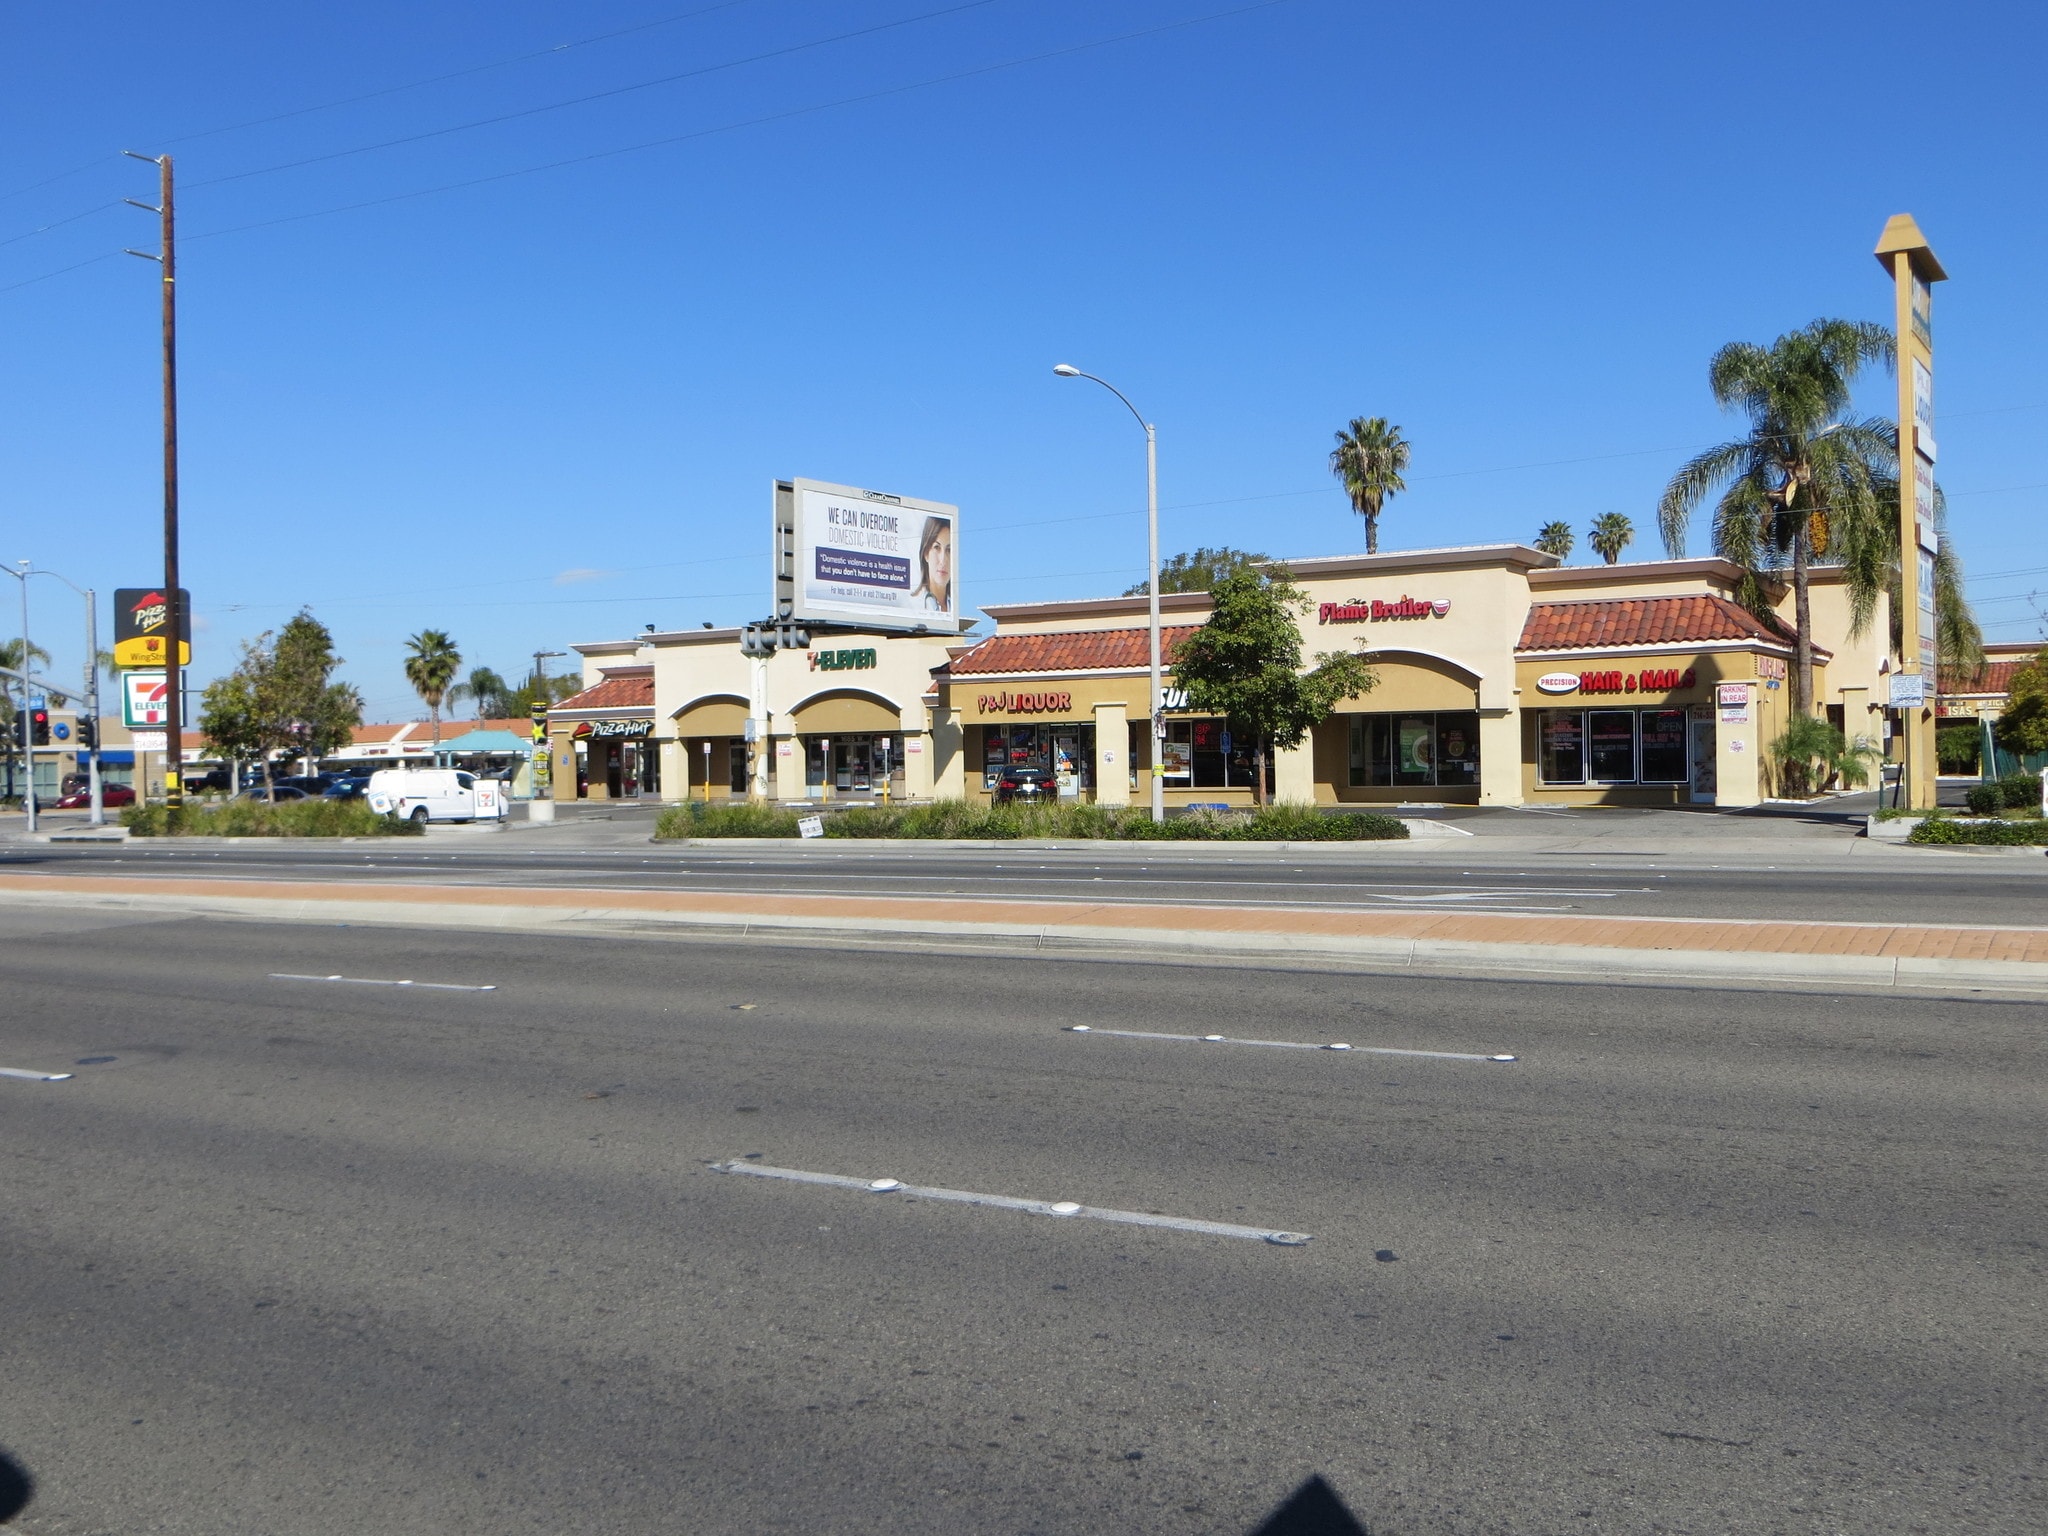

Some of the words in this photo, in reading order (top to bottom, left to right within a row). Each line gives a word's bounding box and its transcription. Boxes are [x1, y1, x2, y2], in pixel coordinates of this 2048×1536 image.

[828, 507, 840, 524] WE
[842, 511, 858, 528] CAN
[860, 512, 899, 534] OVERCOME
[828, 527, 865, 547] DOMESTIC
[866, 534, 899, 551] VIOLENCE
[820, 564, 832, 574] that
[832, 567, 843, 576] you
[843, 567, 857, 577] don't
[857, 569, 870, 578] have
[871, 571, 877, 579] to
[877, 571, 889, 580] face
[848, 557, 868, 568] violence
[868, 560, 874, 568] is
[878, 561, 893, 571] health
[893, 564, 907, 573] issue
[1320, 602, 1369, 622] Flame
[1371, 596, 1432, 619] Broiler
[142, 612, 166, 629] Hut
[130, 652, 166, 663] WingStre
[1541, 678, 1578, 686] PRECISION
[1581, 671, 1623, 691] HAIR
[1626, 674, 1637, 690] &
[1641, 668, 1696, 690] NAILS
[1720, 684, 1746, 694] PARKING
[1721, 694, 1728, 702] IN
[1728, 693, 1747, 702] REAR
[1007, 692, 1071, 713] LIQUOR
[591, 721, 625, 737] Pizza
[624, 719, 654, 736] Hut
[1656, 722, 1683, 732] OPEN
